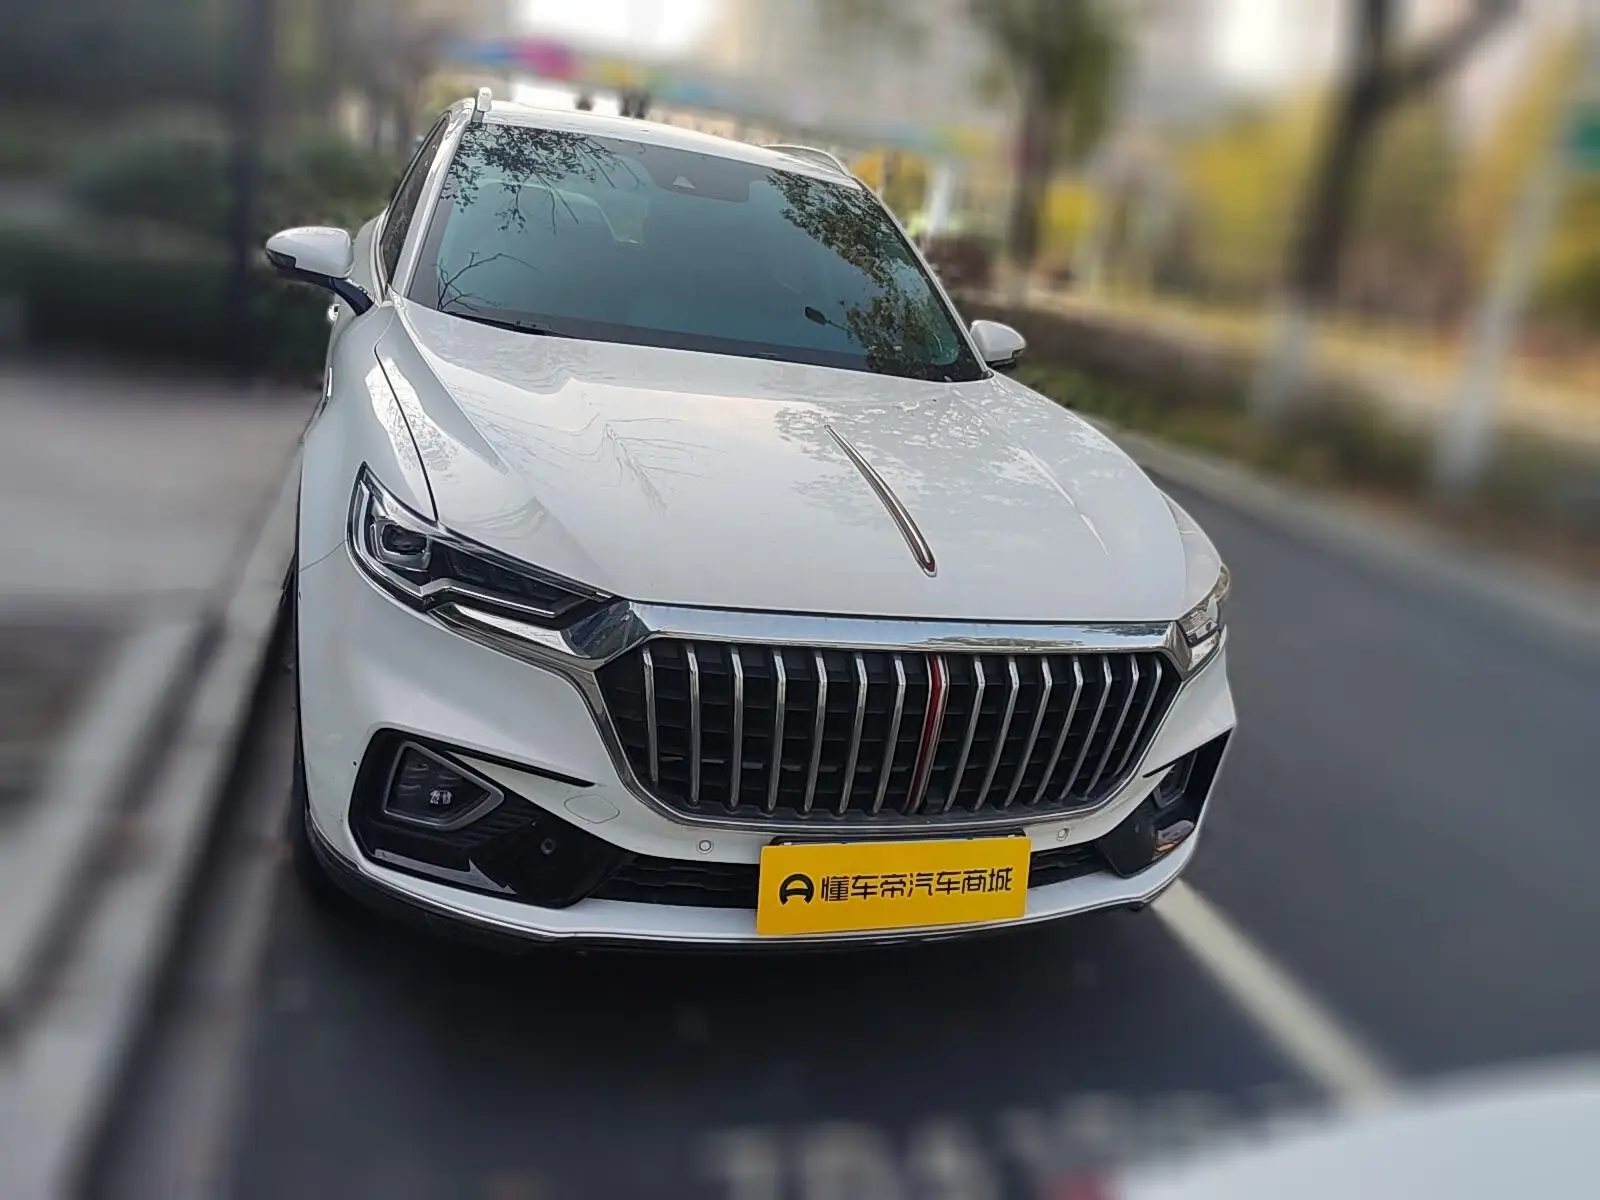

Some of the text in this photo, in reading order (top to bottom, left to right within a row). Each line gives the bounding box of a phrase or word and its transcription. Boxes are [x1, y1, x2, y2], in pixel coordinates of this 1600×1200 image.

[820, 867, 1013, 902] 懂车帝汽车商城
